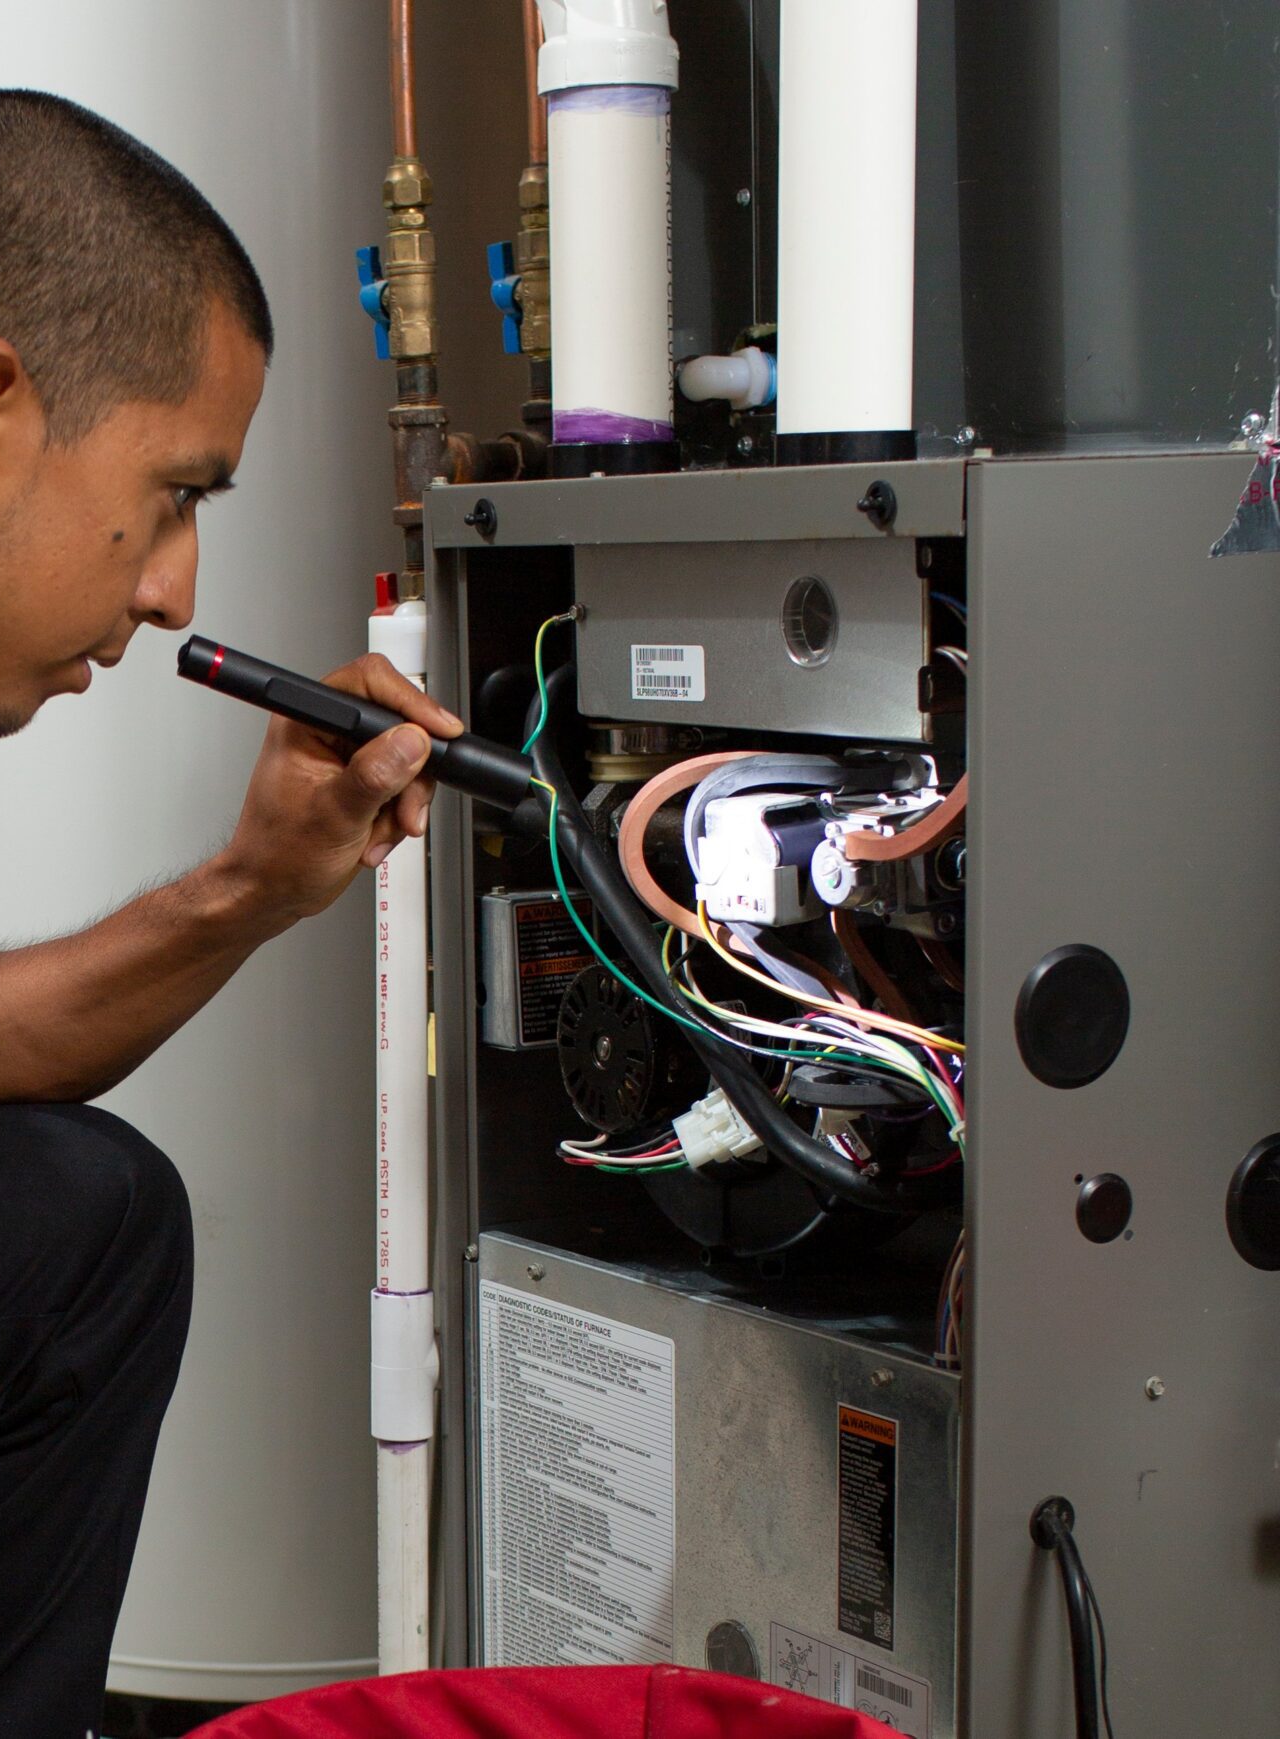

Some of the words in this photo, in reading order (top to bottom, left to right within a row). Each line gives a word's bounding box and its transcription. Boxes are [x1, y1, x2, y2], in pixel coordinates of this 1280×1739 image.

[380, 921, 389, 961] 23°C
[380, 1159, 389, 1199] ASTM
[380, 1208, 389, 1218] D
[380, 1230, 389, 1268] 1785
[483, 1290, 496, 1301] CODE
[498, 1294, 532, 1312] DIAGNOSTIC
[532, 1305, 575, 1326] CODES/STATUS
[575, 1318, 583, 1327] OF
[584, 1321, 612, 1338] FURNACE
[850, 1416, 893, 1440] WARNING
